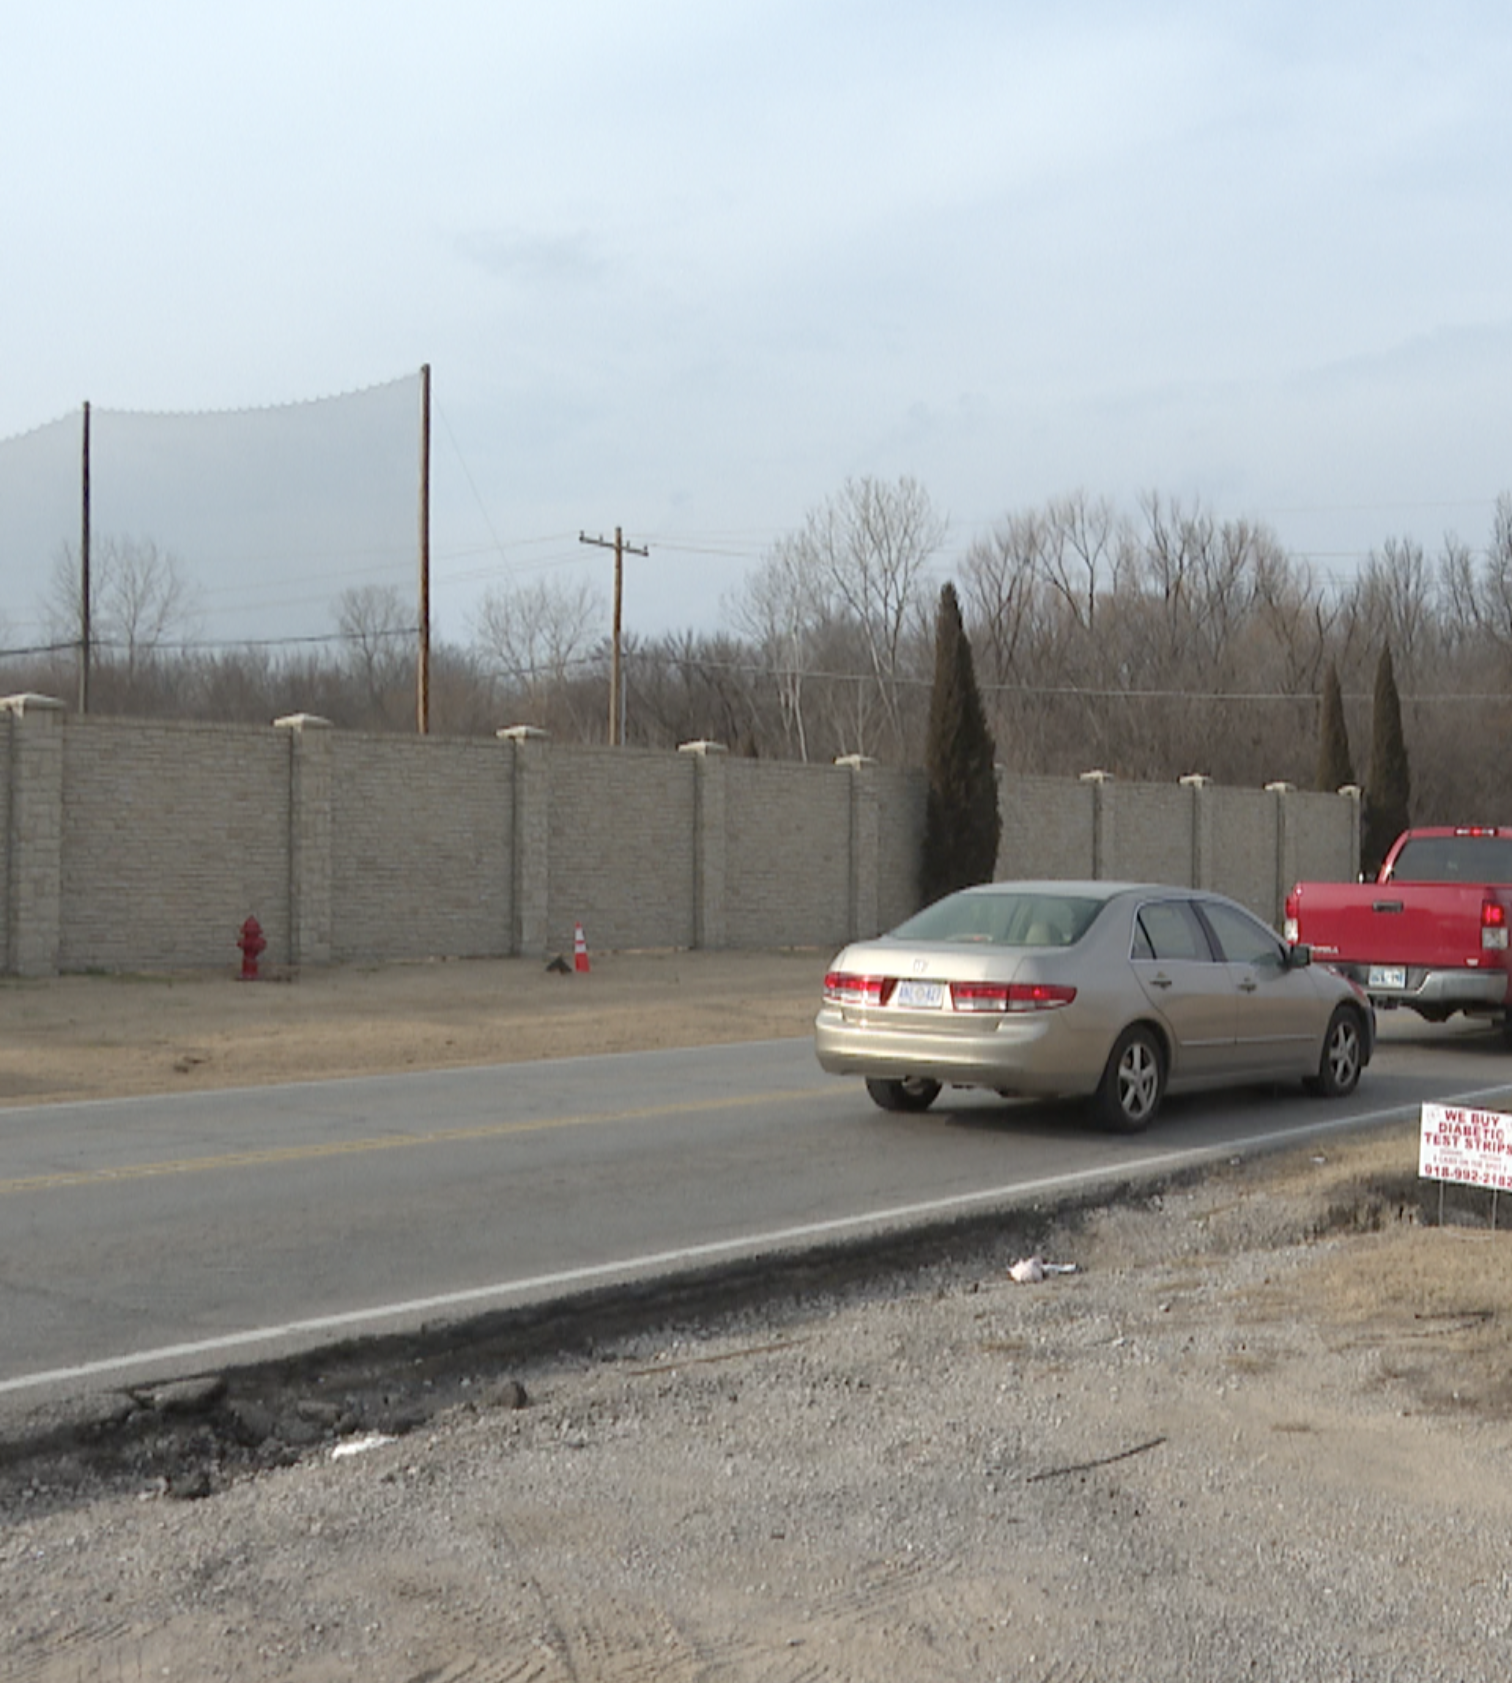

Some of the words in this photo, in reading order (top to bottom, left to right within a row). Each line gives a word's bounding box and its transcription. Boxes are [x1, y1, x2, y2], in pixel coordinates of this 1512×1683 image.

[1445, 1110, 1465, 1123] WE
[1471, 1113, 1499, 1128] BUY
[1424, 1132, 1459, 1148] TEST
[1439, 1122, 1504, 1141] DIABETIC
